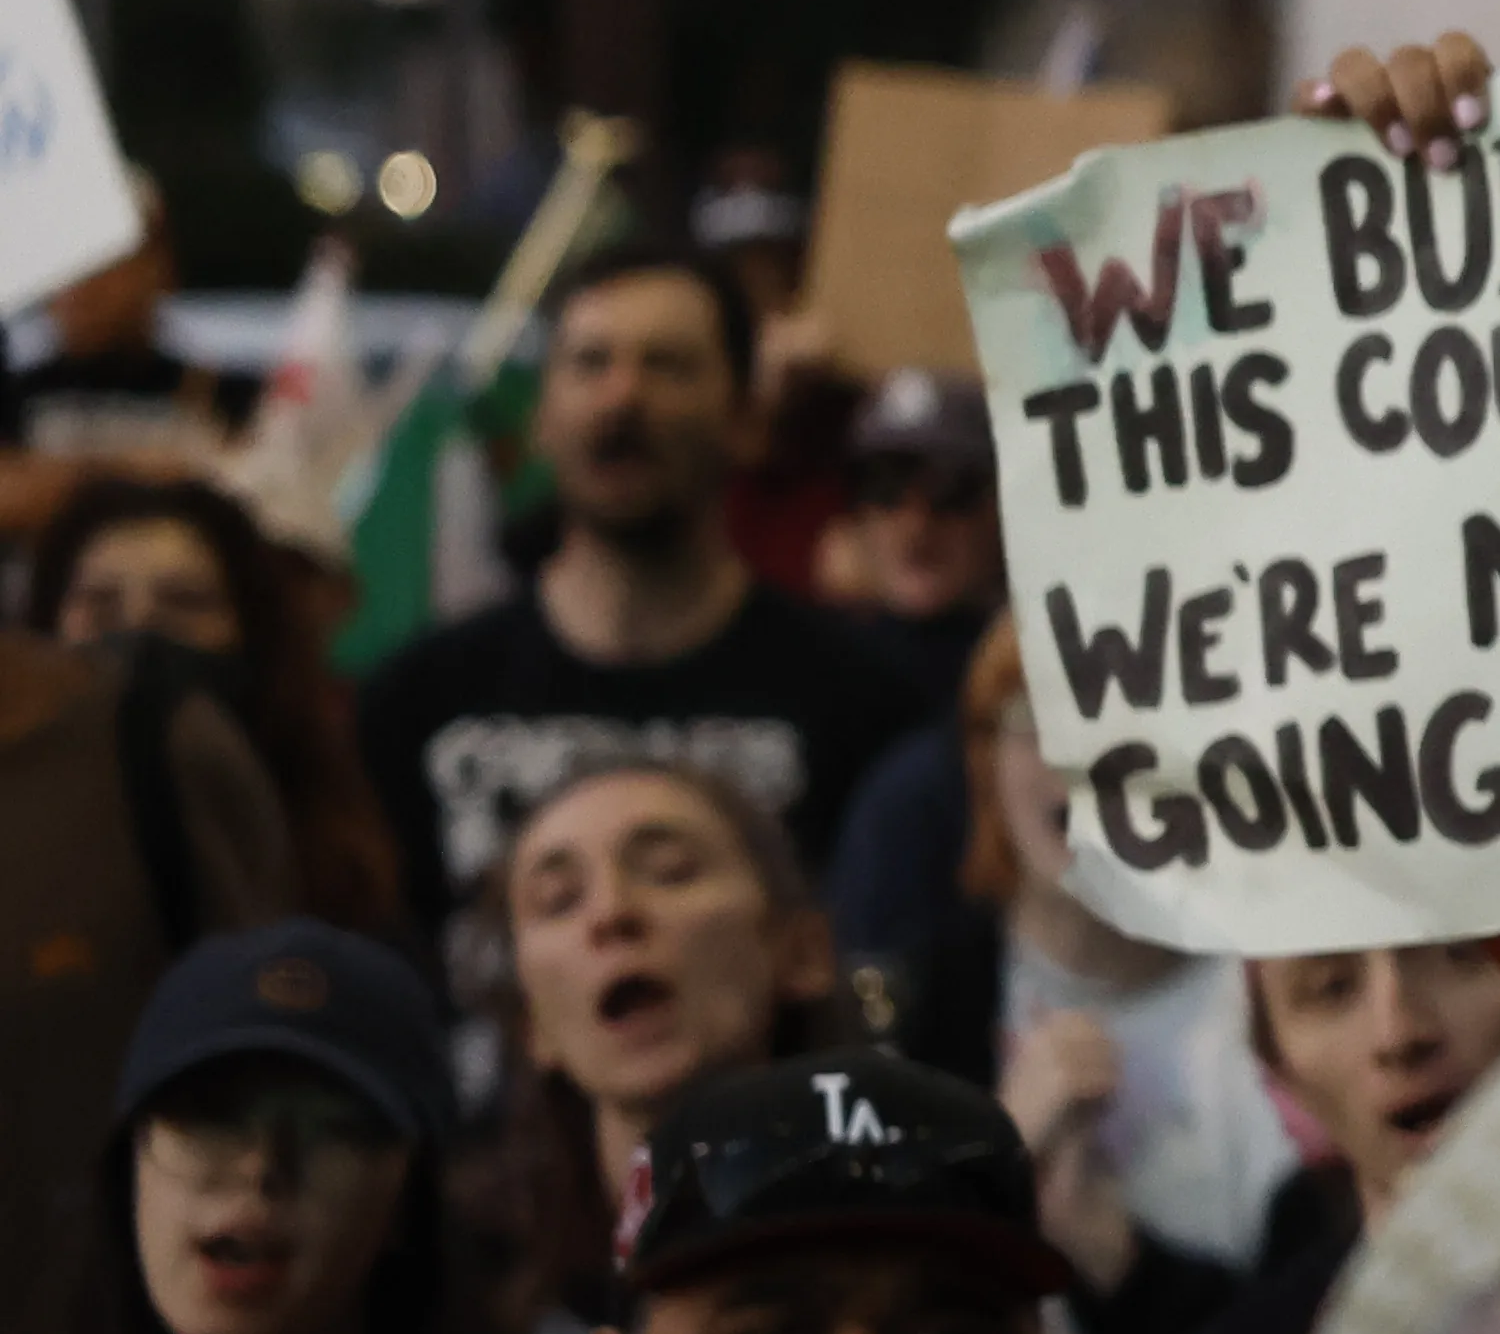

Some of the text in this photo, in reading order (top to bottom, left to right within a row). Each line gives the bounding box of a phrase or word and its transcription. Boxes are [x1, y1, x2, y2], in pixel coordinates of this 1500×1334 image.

[1036, 181, 1274, 363] WE
[1022, 351, 1293, 508] THIS
[1045, 551, 1399, 720] WE'RE
